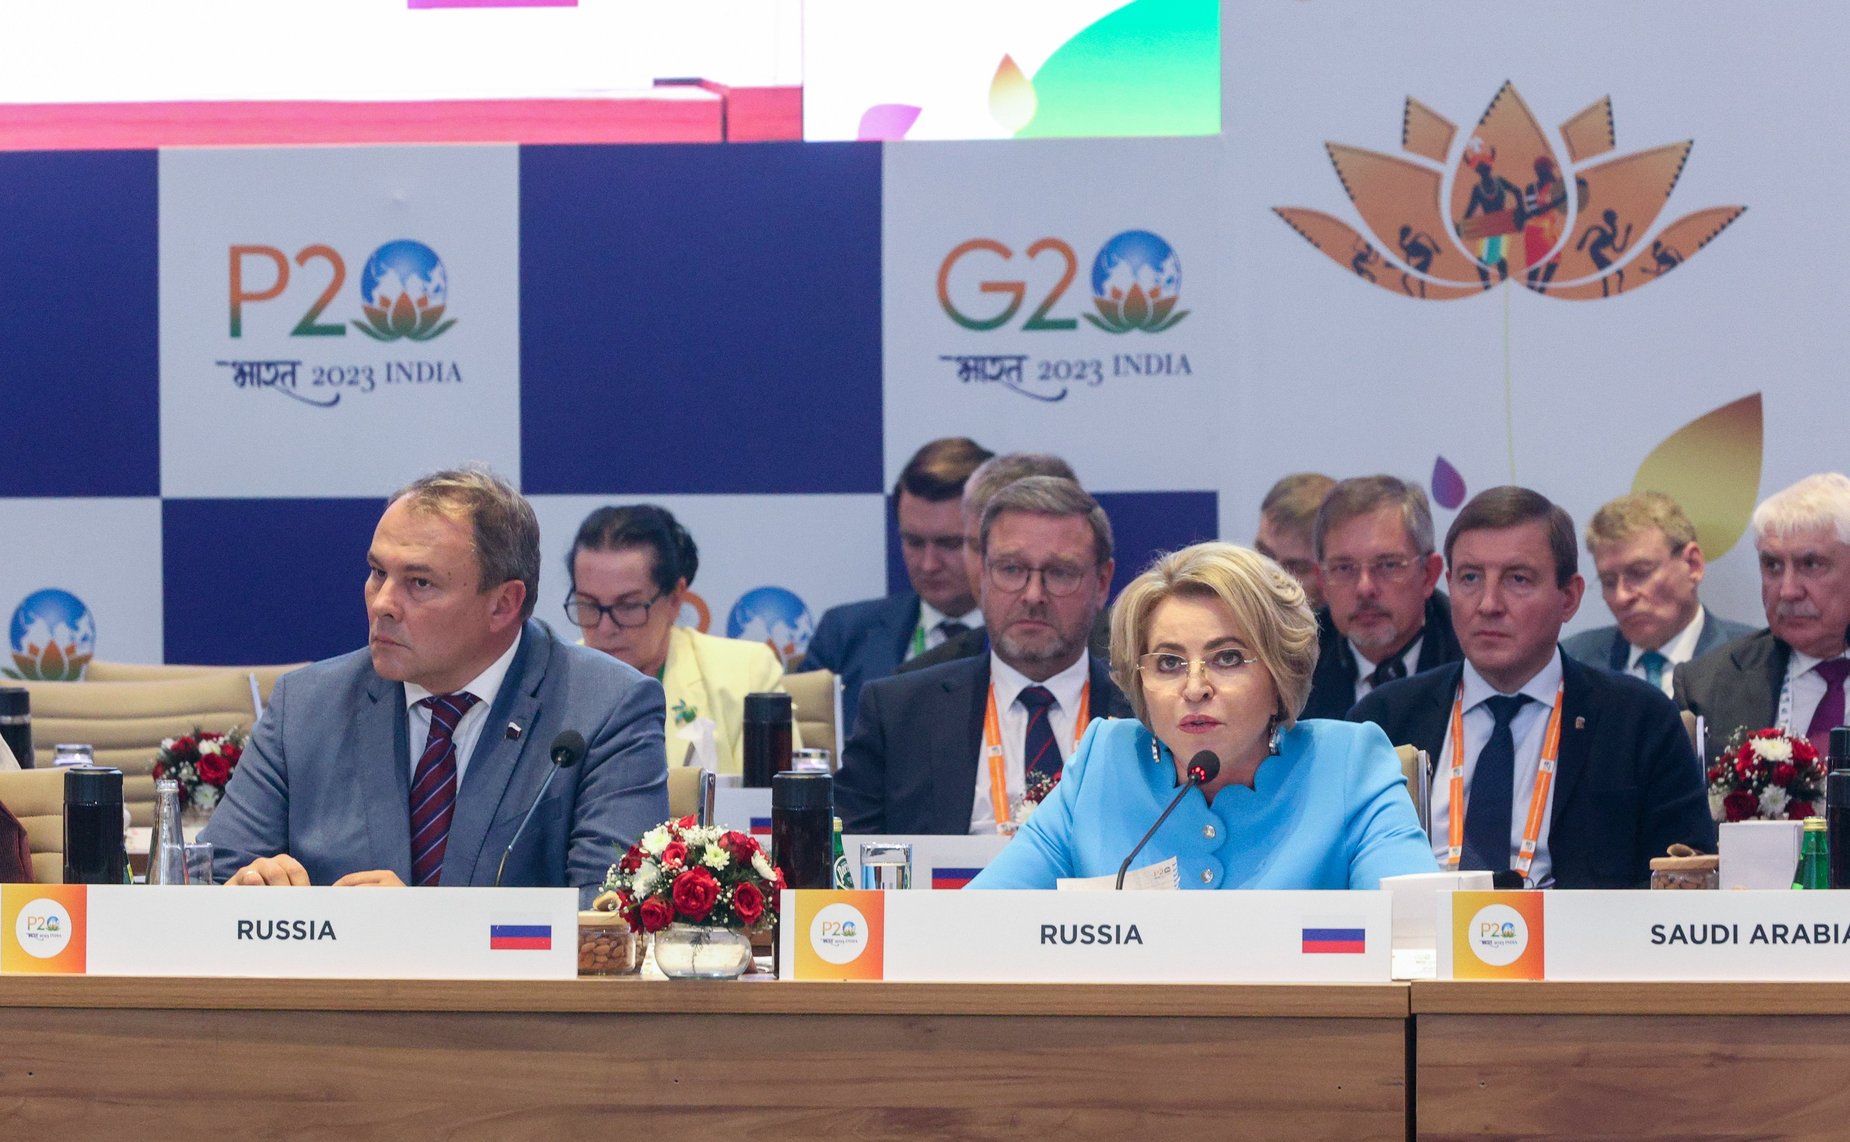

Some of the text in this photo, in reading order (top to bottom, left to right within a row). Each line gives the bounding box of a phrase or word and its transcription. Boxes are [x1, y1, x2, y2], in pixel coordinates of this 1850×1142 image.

[312, 366, 375, 391] 2023
[386, 361, 462, 383] INDIA
[1038, 360, 1103, 385] 2023
[1113, 354, 1193, 377] INDIA
[238, 919, 337, 941] RUSSIA
[1040, 924, 1143, 945] RUSSIA
[1651, 923, 1739, 945] SAUDI
